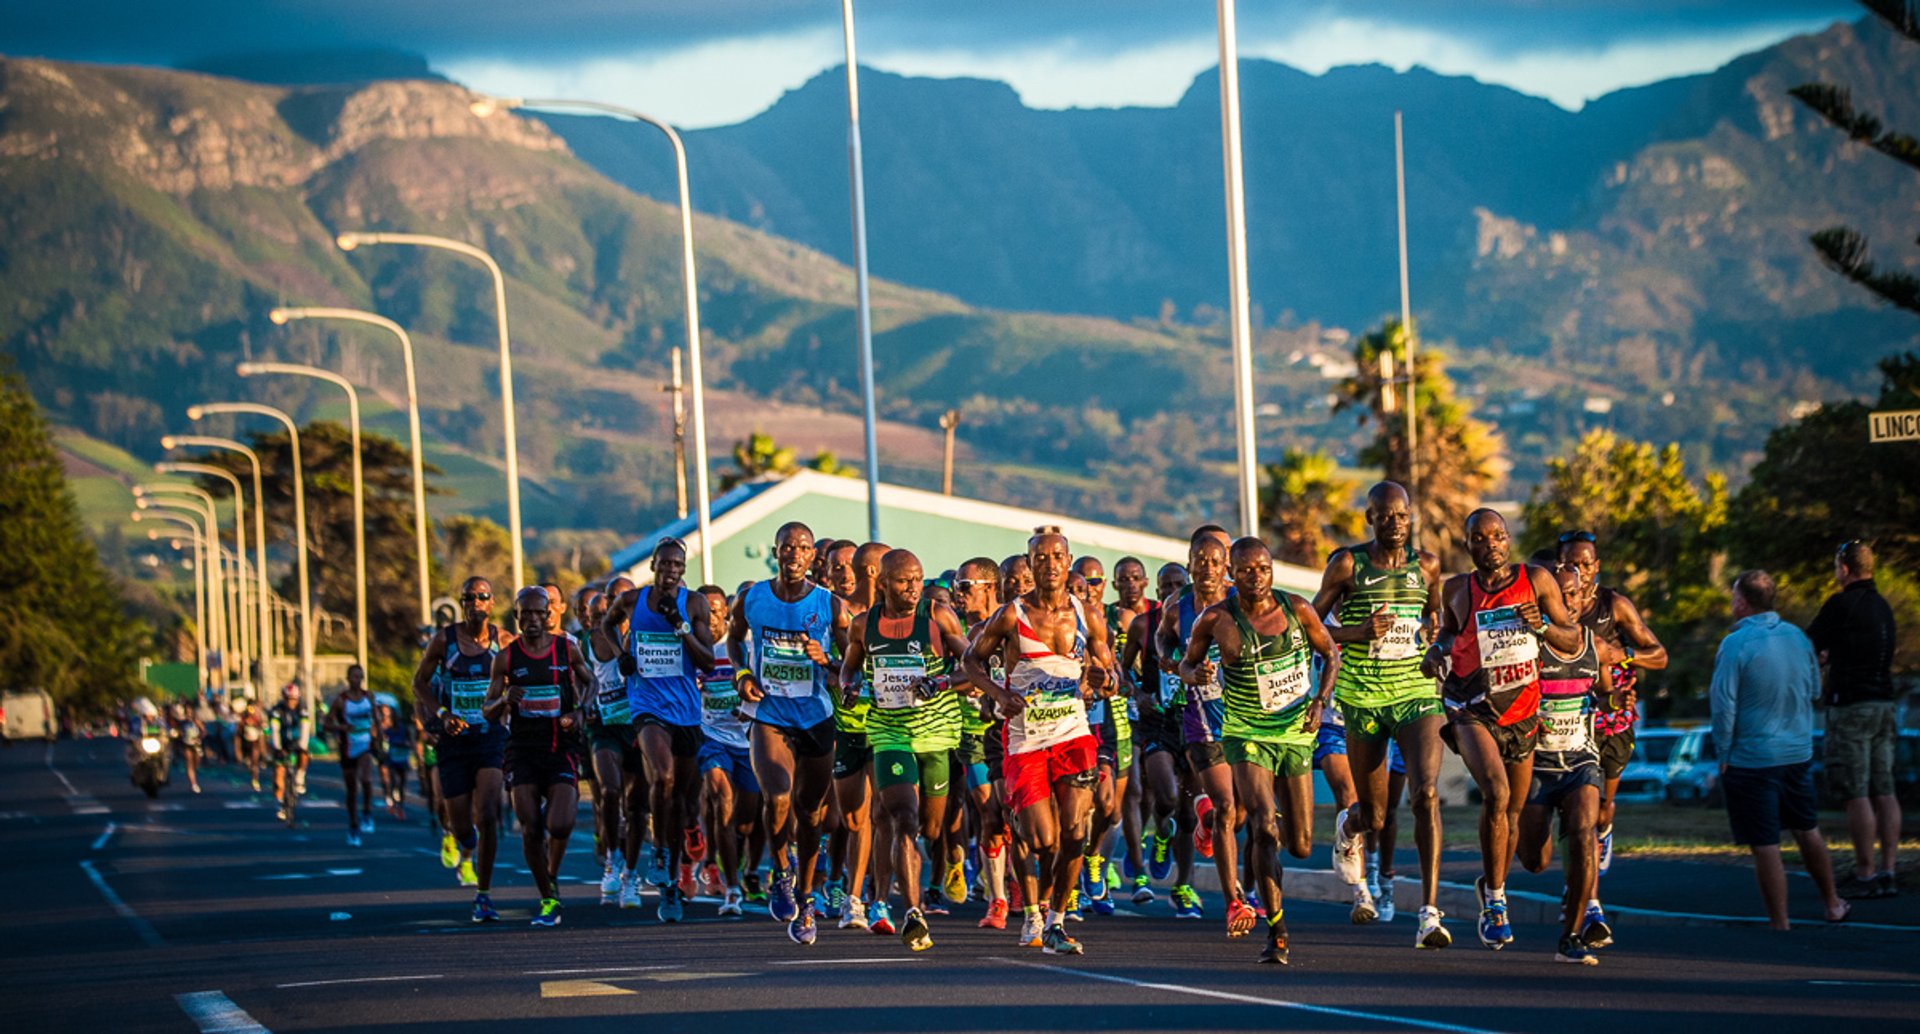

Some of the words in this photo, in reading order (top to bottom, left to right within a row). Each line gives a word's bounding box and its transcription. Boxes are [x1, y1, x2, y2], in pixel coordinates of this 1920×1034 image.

[1487, 623, 1528, 640] Calvin
[638, 646, 681, 656] Bernard
[763, 664, 812, 680] A25131
[1268, 671, 1304, 689] Justin
[1547, 716, 1581, 726] David
